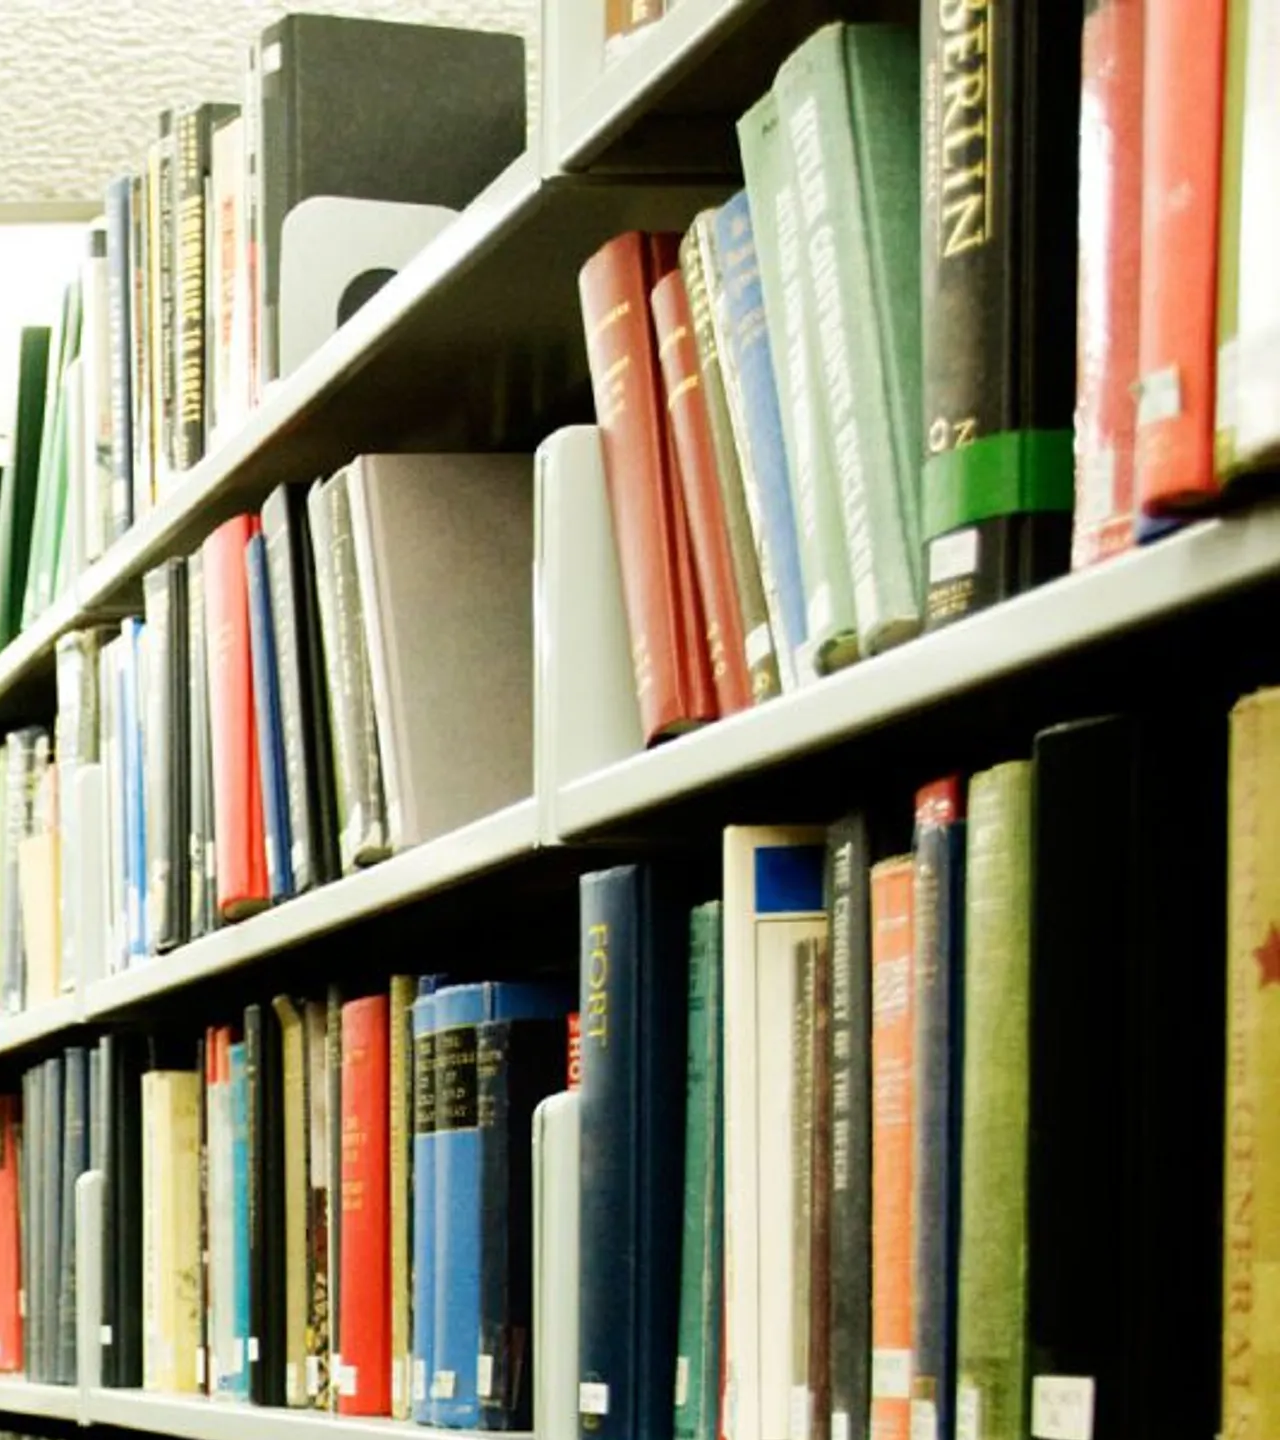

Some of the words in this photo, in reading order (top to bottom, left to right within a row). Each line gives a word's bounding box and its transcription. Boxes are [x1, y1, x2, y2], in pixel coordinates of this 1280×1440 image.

[790, 94, 828, 223] HITLER
[939, 0, 987, 259] BERLIN
[808, 226, 855, 424] CONFRONTS
[835, 841, 851, 888] THE
[834, 894, 850, 1022] CONQUEST
[834, 1030, 850, 1062] OF
[834, 1068, 850, 1114] THE
[833, 1119, 849, 1192] REICH
